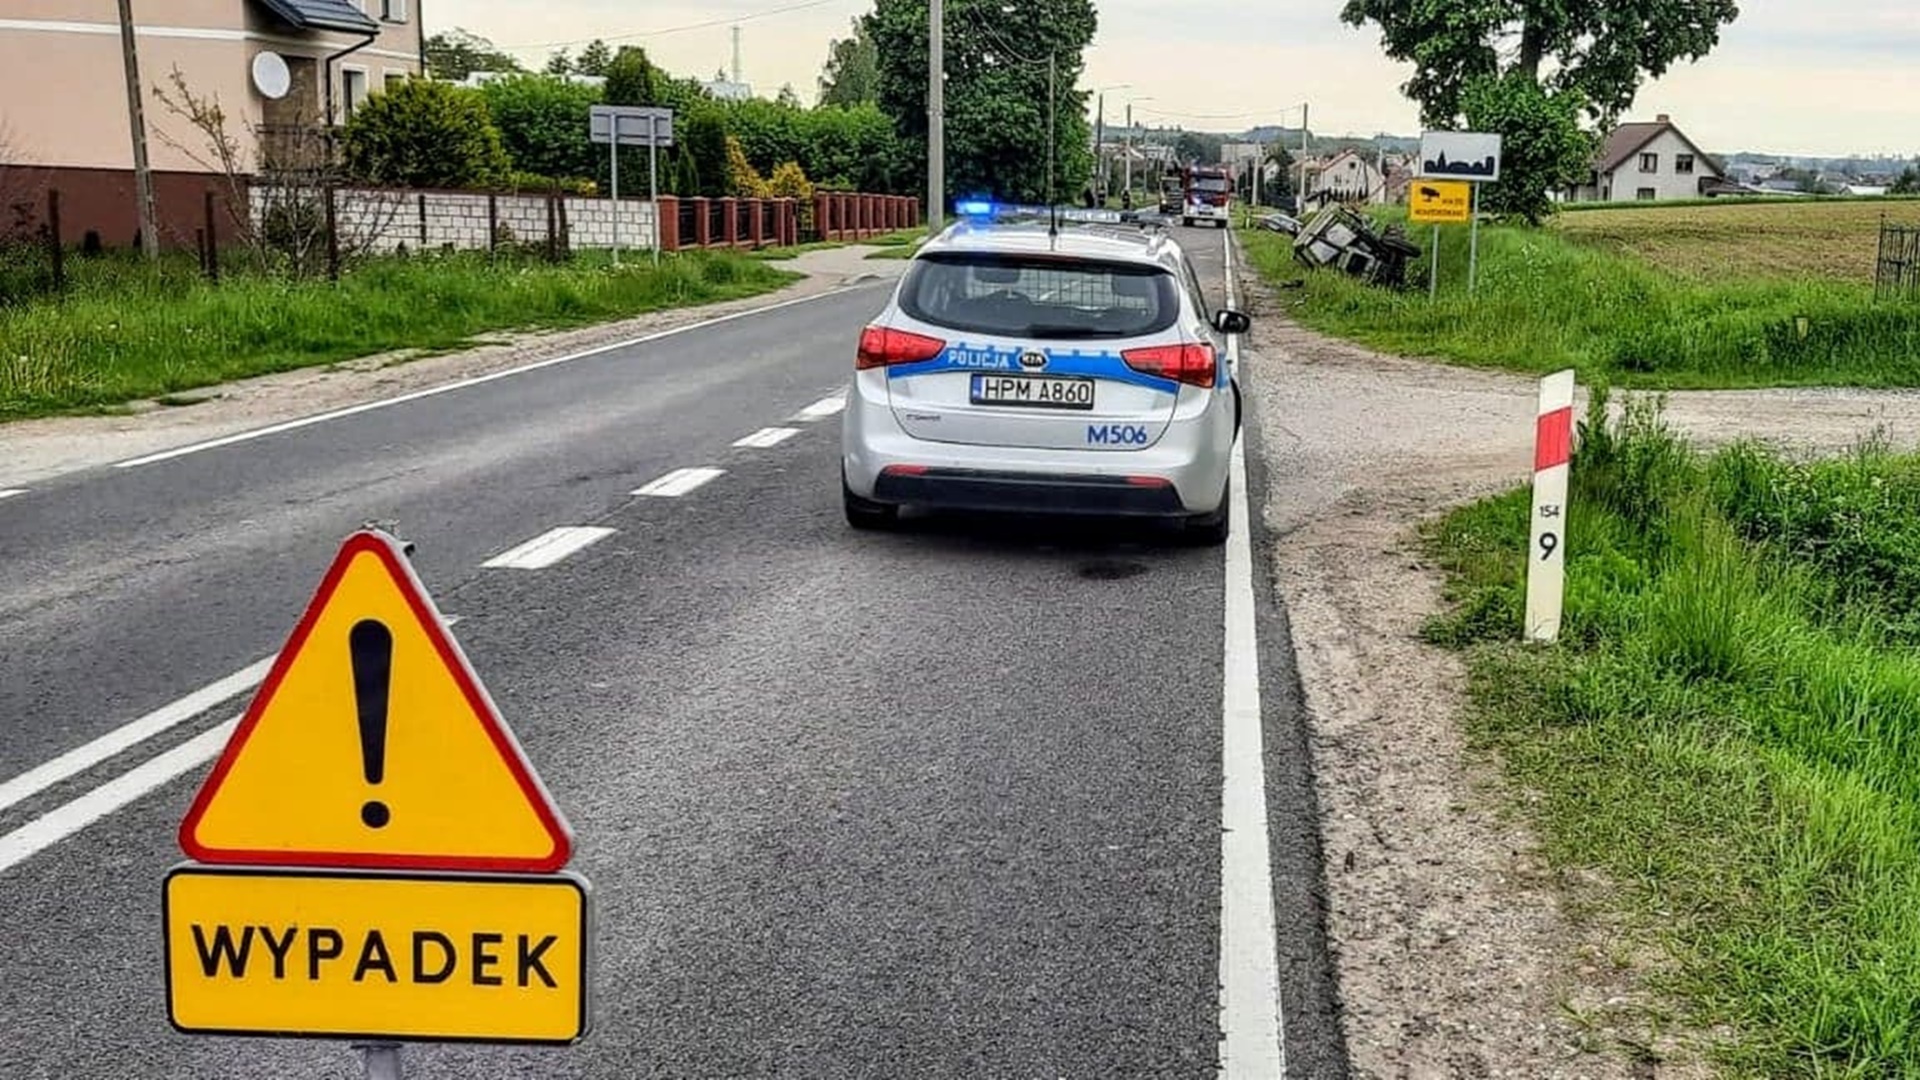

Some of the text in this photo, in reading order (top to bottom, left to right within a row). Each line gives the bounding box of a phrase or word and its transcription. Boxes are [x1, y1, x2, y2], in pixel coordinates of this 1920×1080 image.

[948, 350, 1010, 368] POLICJA
[985, 378, 1090, 403] HPM A860
[1087, 425, 1147, 444] M506
[1540, 505, 1559, 518] 154
[1539, 532, 1557, 561] 9
[191, 924, 559, 989] WYPADEK
